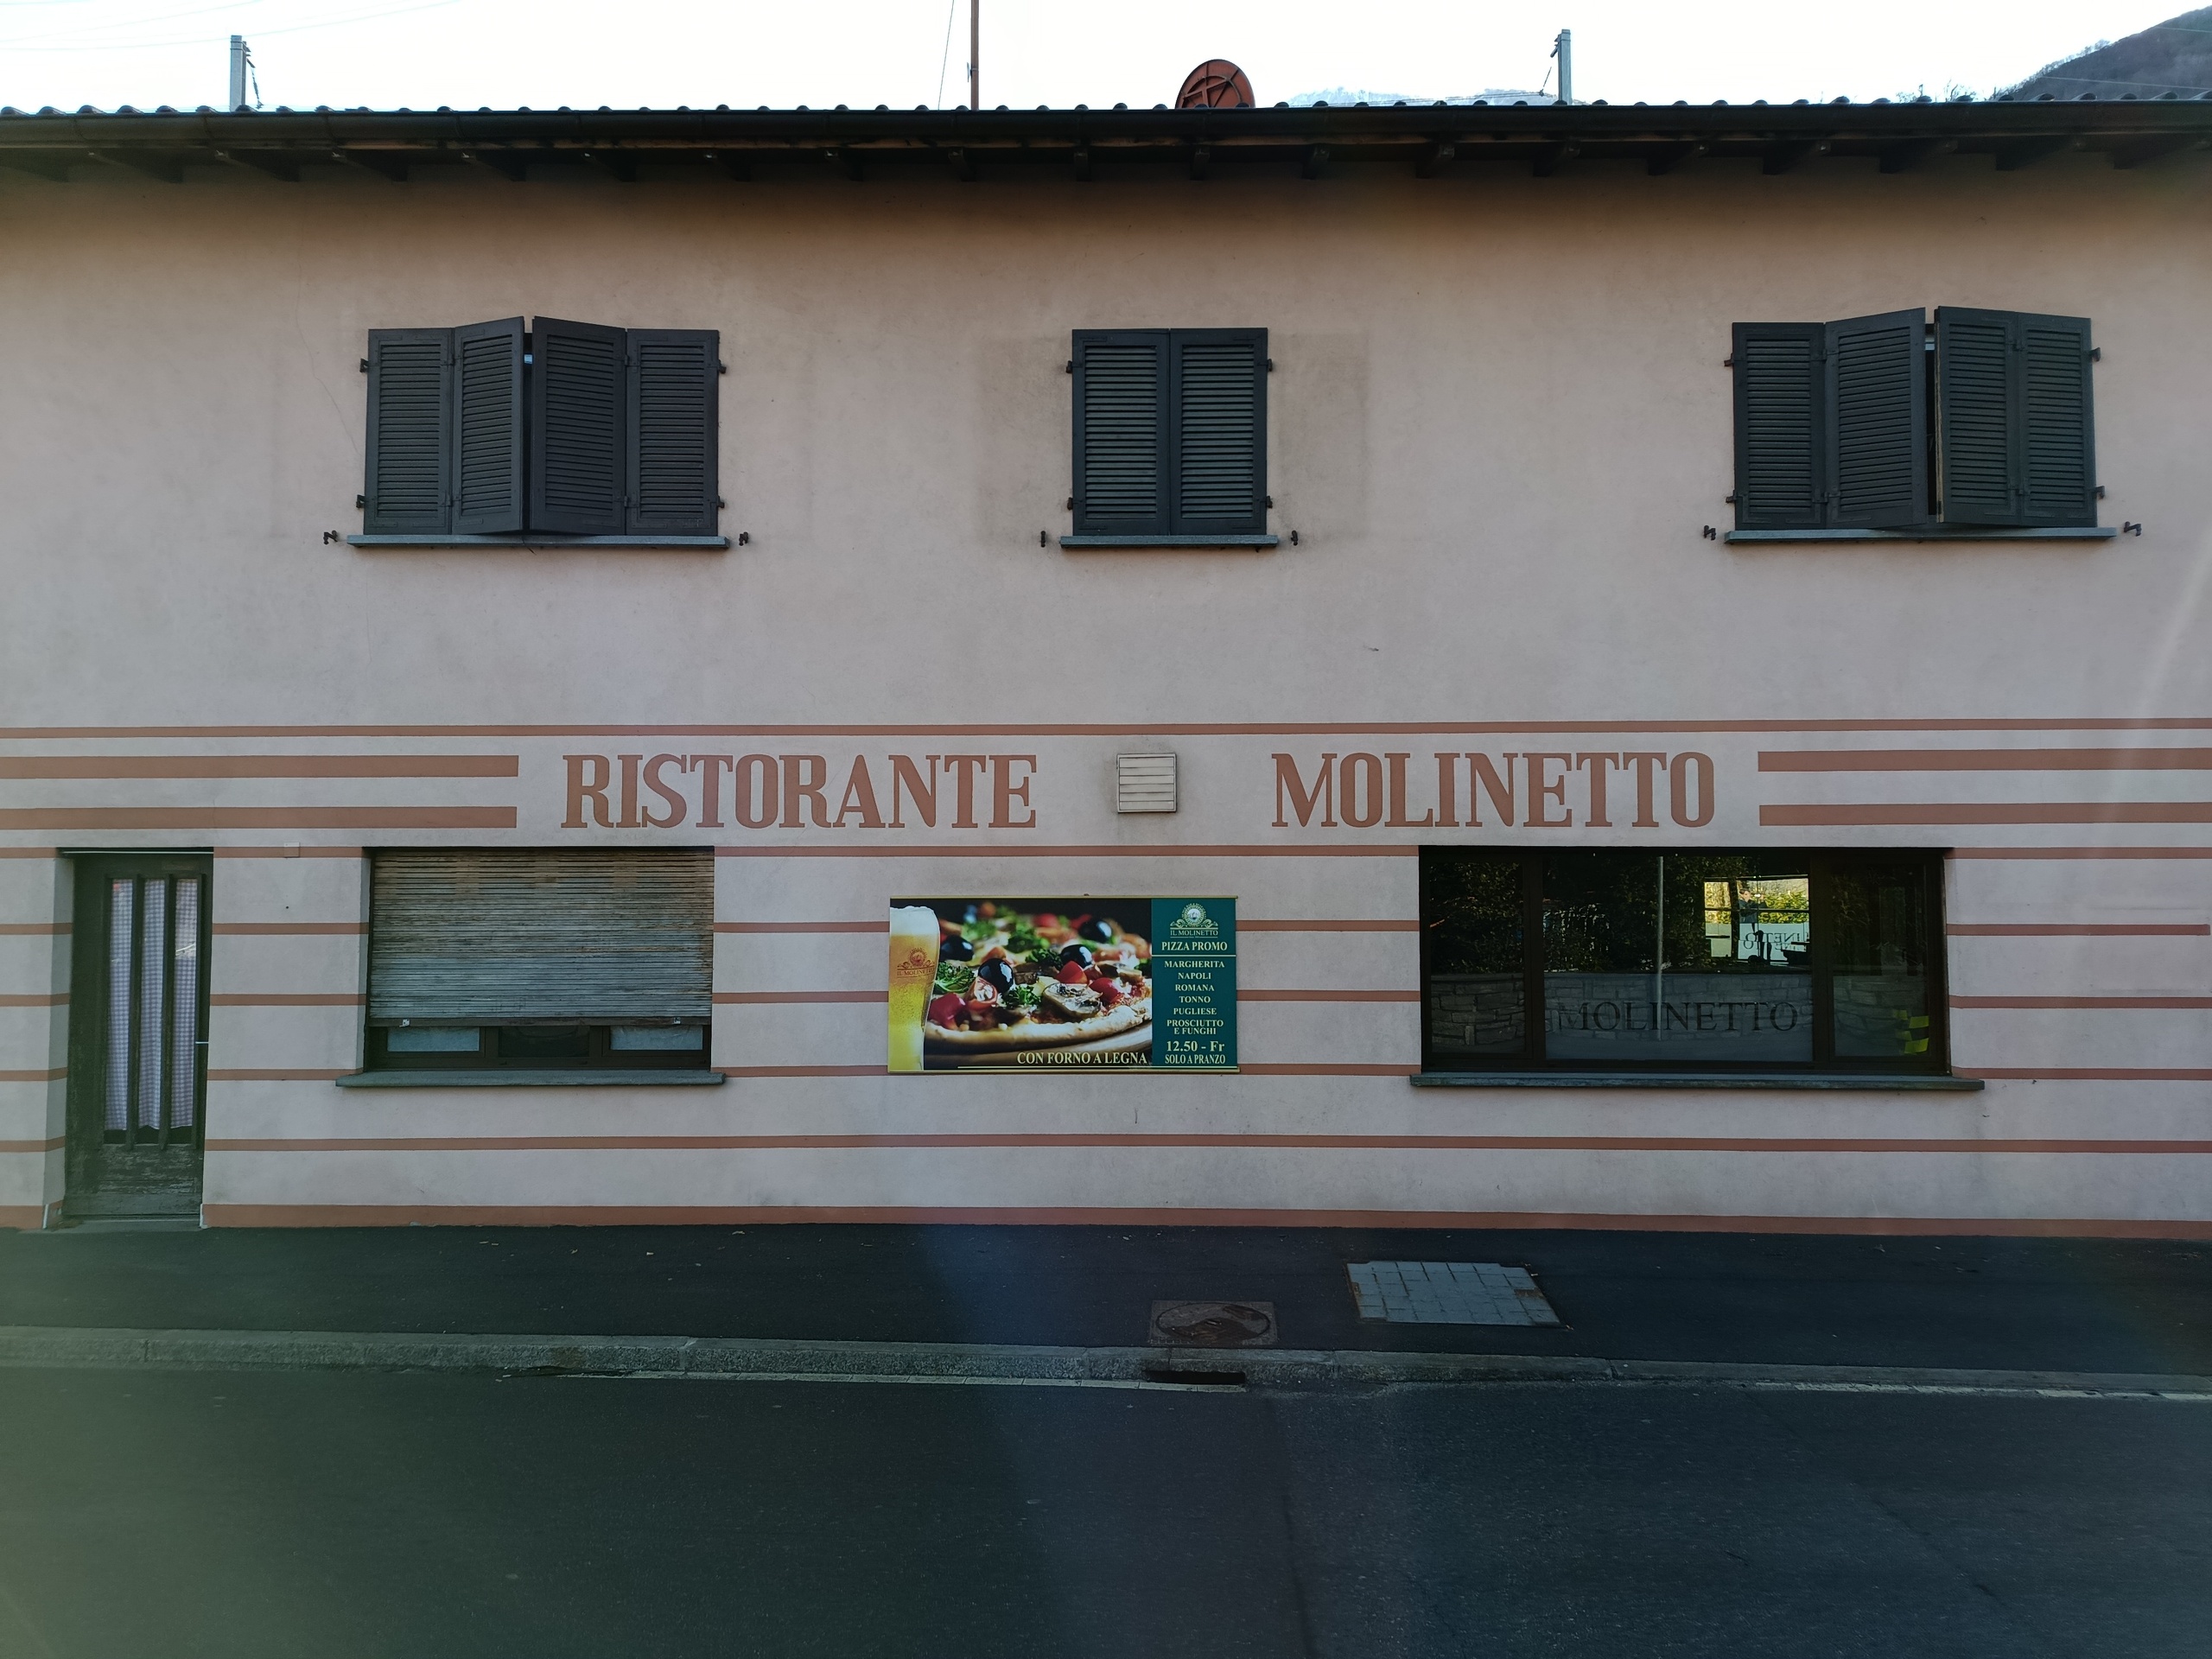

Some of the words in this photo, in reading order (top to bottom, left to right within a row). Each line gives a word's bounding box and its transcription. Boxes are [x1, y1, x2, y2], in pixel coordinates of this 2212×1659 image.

[561, 753, 1037, 829] RISTORANTE
[1271, 751, 1715, 828] MOLINETTO
[1161, 942, 1190, 950] PIZZA
[1192, 942, 1228, 950] PROMO
[1558, 1001, 1798, 1032] MOLINETTO
[1166, 1040, 1198, 1052] 12.50
[1211, 1040, 1225, 1052] Fr
[1016, 1052, 1044, 1065] CON
[1047, 1052, 1091, 1065] FORNO
[1093, 1052, 1102, 1065] A
[1104, 1052, 1147, 1065] LEGNA
[1165, 1054, 1186, 1065] SOLO
[1187, 1054, 1192, 1065] A
[1194, 1054, 1226, 1065] PRANZO
